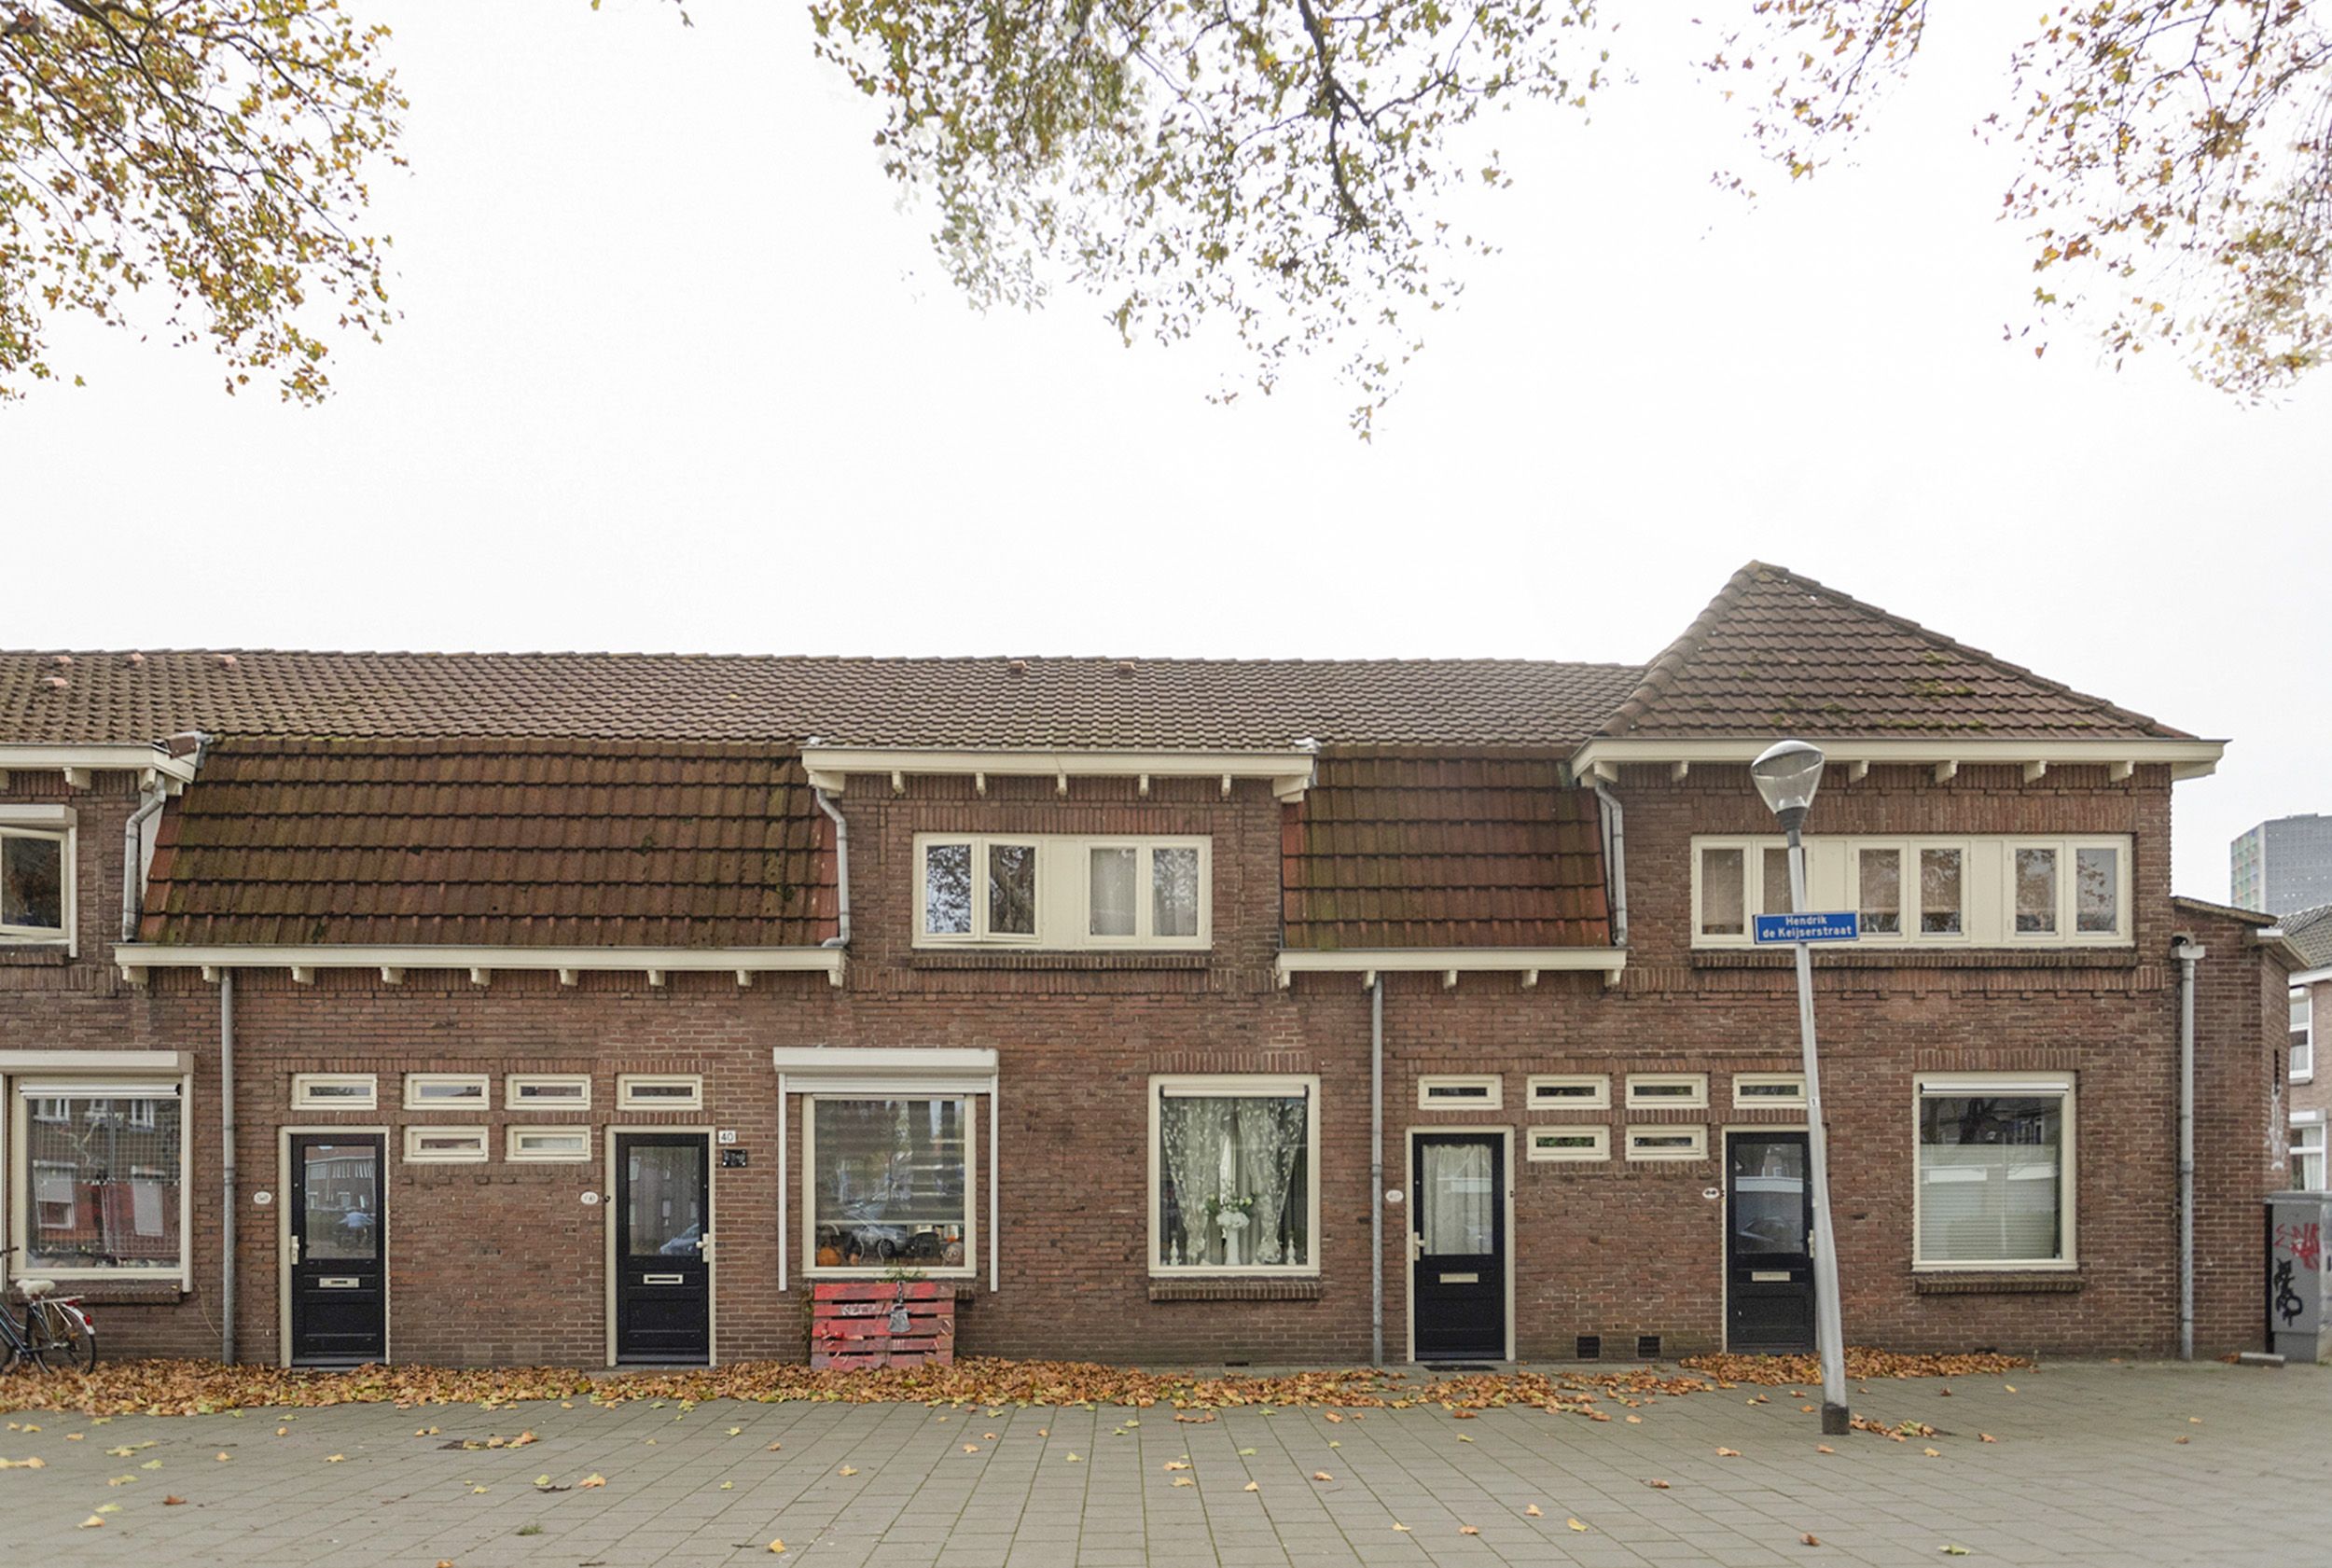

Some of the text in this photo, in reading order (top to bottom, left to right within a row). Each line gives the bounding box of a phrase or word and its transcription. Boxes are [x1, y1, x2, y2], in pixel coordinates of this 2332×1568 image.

[1785, 915, 1827, 925] Hendrik
[1762, 925, 1853, 939] de Keijserstraat
[721, 1132, 734, 1142] 40
